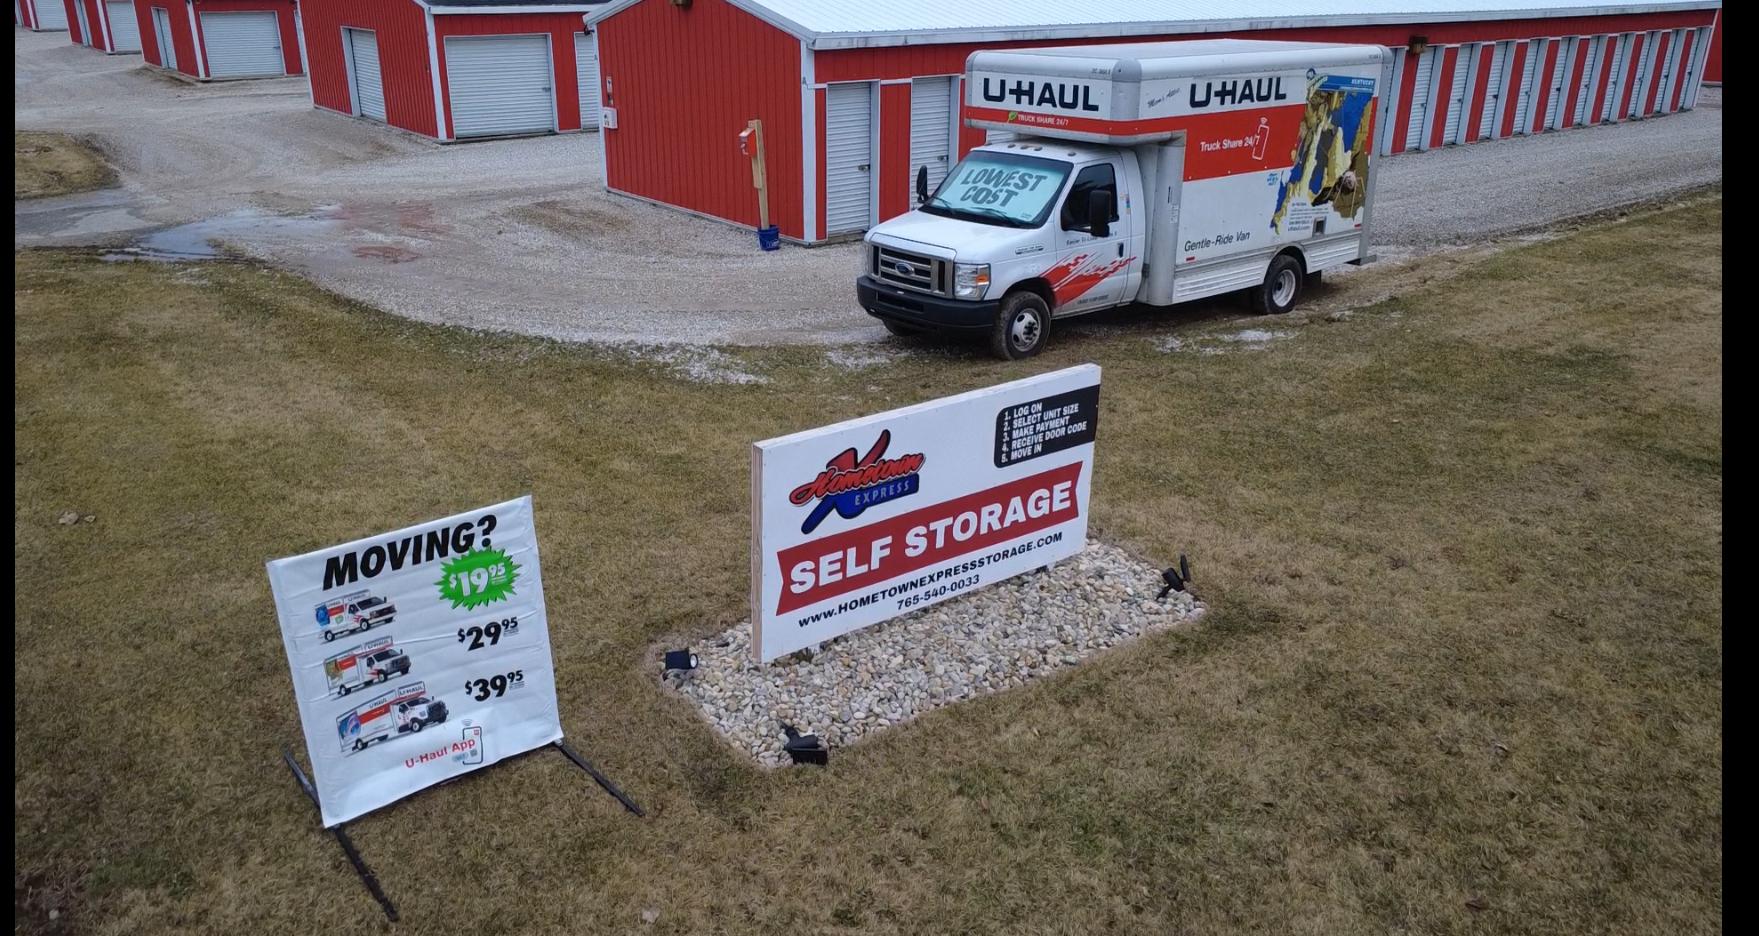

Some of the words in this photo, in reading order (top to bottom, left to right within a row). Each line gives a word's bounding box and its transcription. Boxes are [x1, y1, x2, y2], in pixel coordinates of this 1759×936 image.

[1018, 114, 1035, 123] TRUCK
[1036, 116, 1055, 125] SHARE
[1056, 118, 1069, 126] 24/7
[1200, 140, 1221, 152] Truck
[1222, 138, 1243, 150] Share
[1244, 135, 1260, 147] 24/7
[961, 168, 1048, 191] LOWEST
[960, 186, 1018, 207] COST
[1184, 233, 1234, 252] Gentle-Ride
[1236, 231, 1251, 242] Van
[1003, 422, 1010, 431] 2.
[1012, 413, 1042, 429] SELECT
[1043, 408, 1061, 420] UNIT
[1062, 403, 1079, 414] SIZE
[1004, 411, 1011, 420] 1.
[1013, 406, 1029, 418] LOG
[1031, 402, 1042, 413] ON
[1011, 433, 1044, 450] RECEIVE
[1044, 427, 1066, 441] DOOR
[1067, 421, 1087, 434] CODE
[1012, 425, 1034, 439] MAKE
[1035, 416, 1070, 433] PAYMENT
[1010, 448, 1032, 460] MOVE
[1034, 443, 1042, 454] IN
[789, 452, 926, 506] Hometown
[854, 480, 911, 506] EXPRESS
[789, 536, 893, 594] SELF
[904, 480, 1072, 558] STORAGE
[322, 514, 498, 591] MOVING?
[897, 574, 980, 611] 765-540-0033
[405, 746, 448, 768] U-Haul
[452, 738, 476, 752] App
